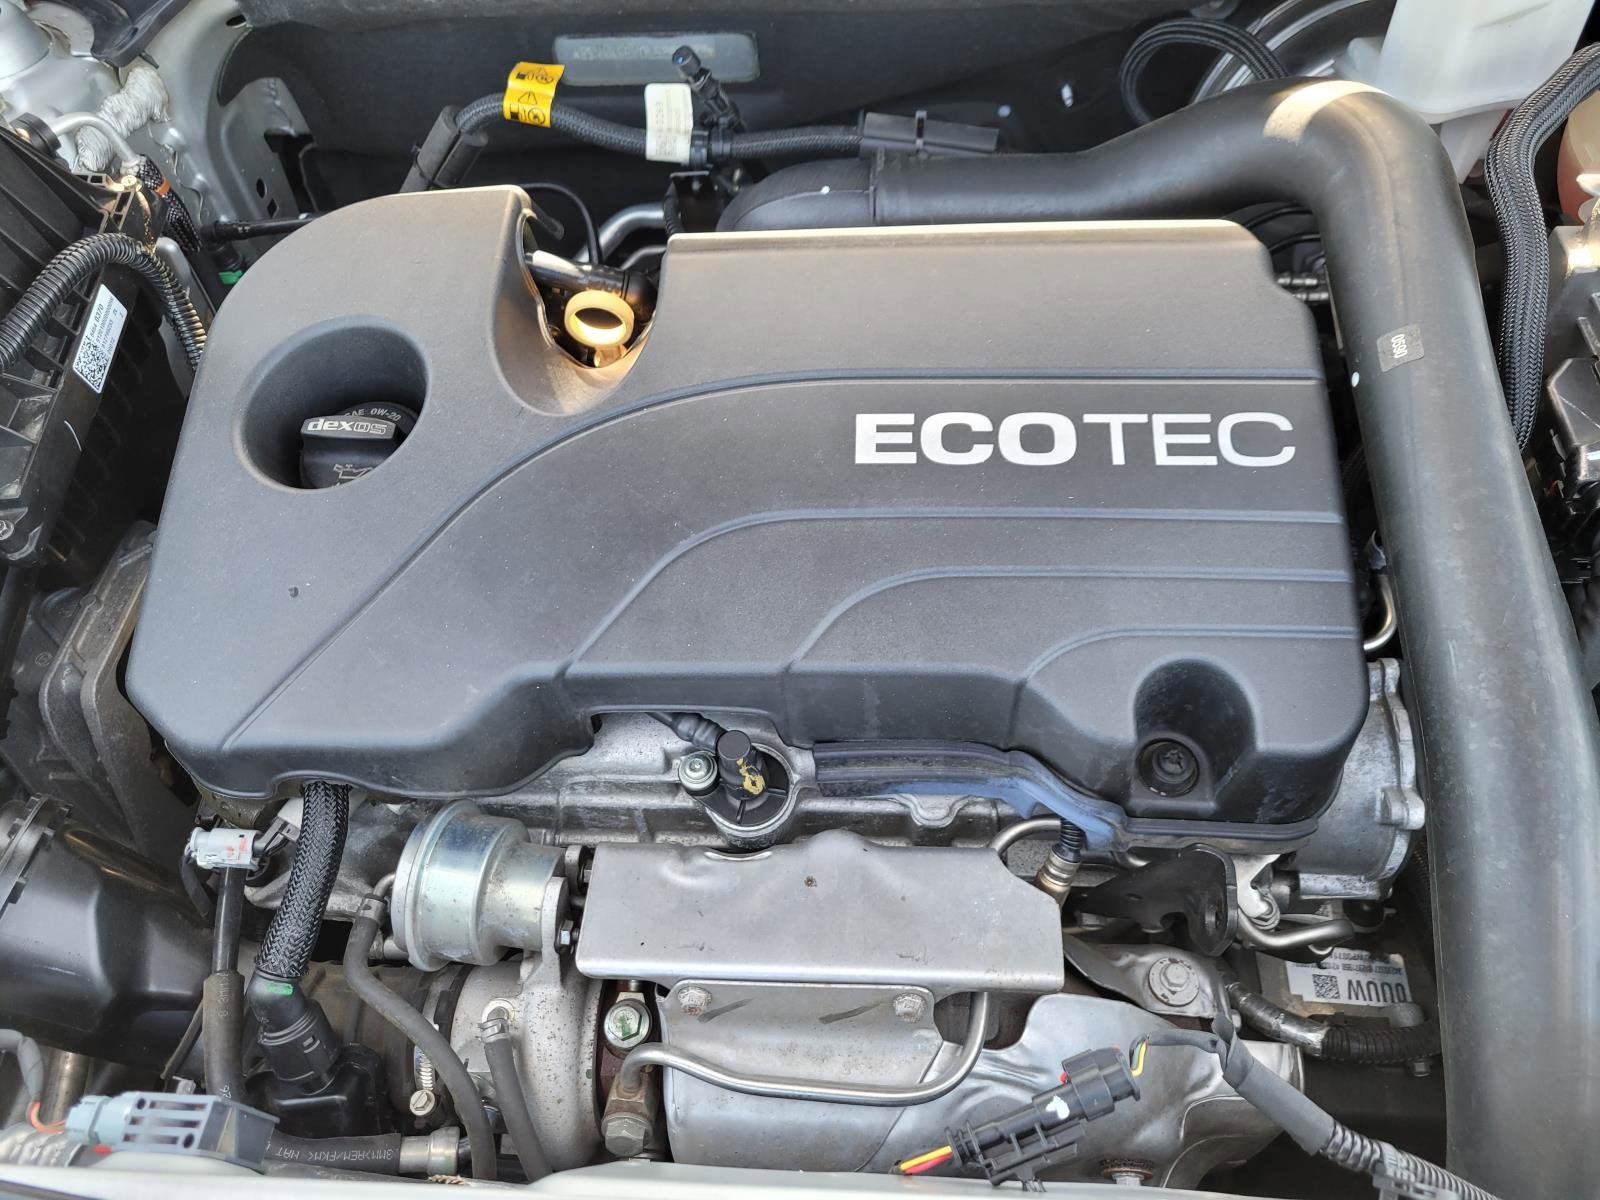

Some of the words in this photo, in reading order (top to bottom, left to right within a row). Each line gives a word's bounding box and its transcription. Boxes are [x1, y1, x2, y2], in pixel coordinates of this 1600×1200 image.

[370, 408, 402, 421] 0W-20
[307, 418, 388, 435] dexos
[854, 412, 1297, 468] ECOTEC
